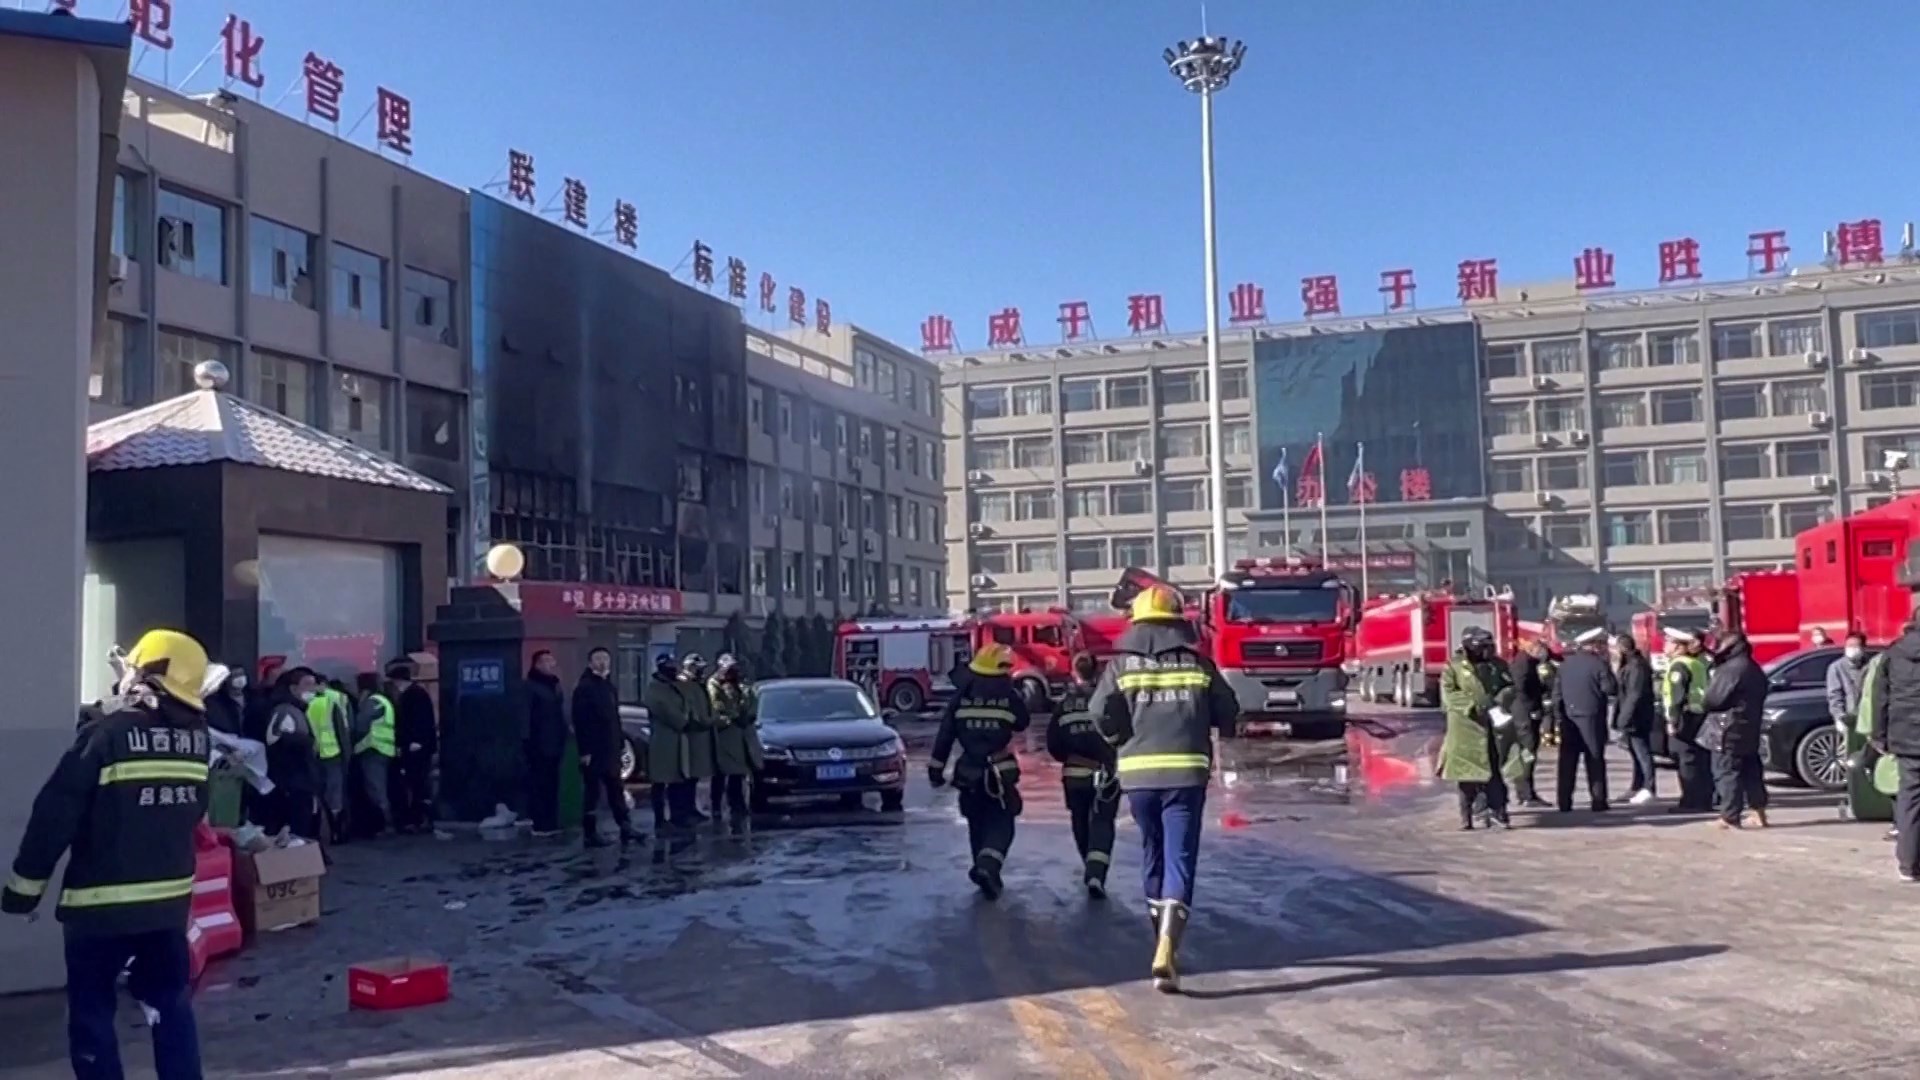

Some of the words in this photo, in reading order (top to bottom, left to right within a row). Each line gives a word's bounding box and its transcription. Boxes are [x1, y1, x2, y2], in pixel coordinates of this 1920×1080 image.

[50, 0, 413, 155] 范化管理
[509, 148, 638, 250] 联建楼
